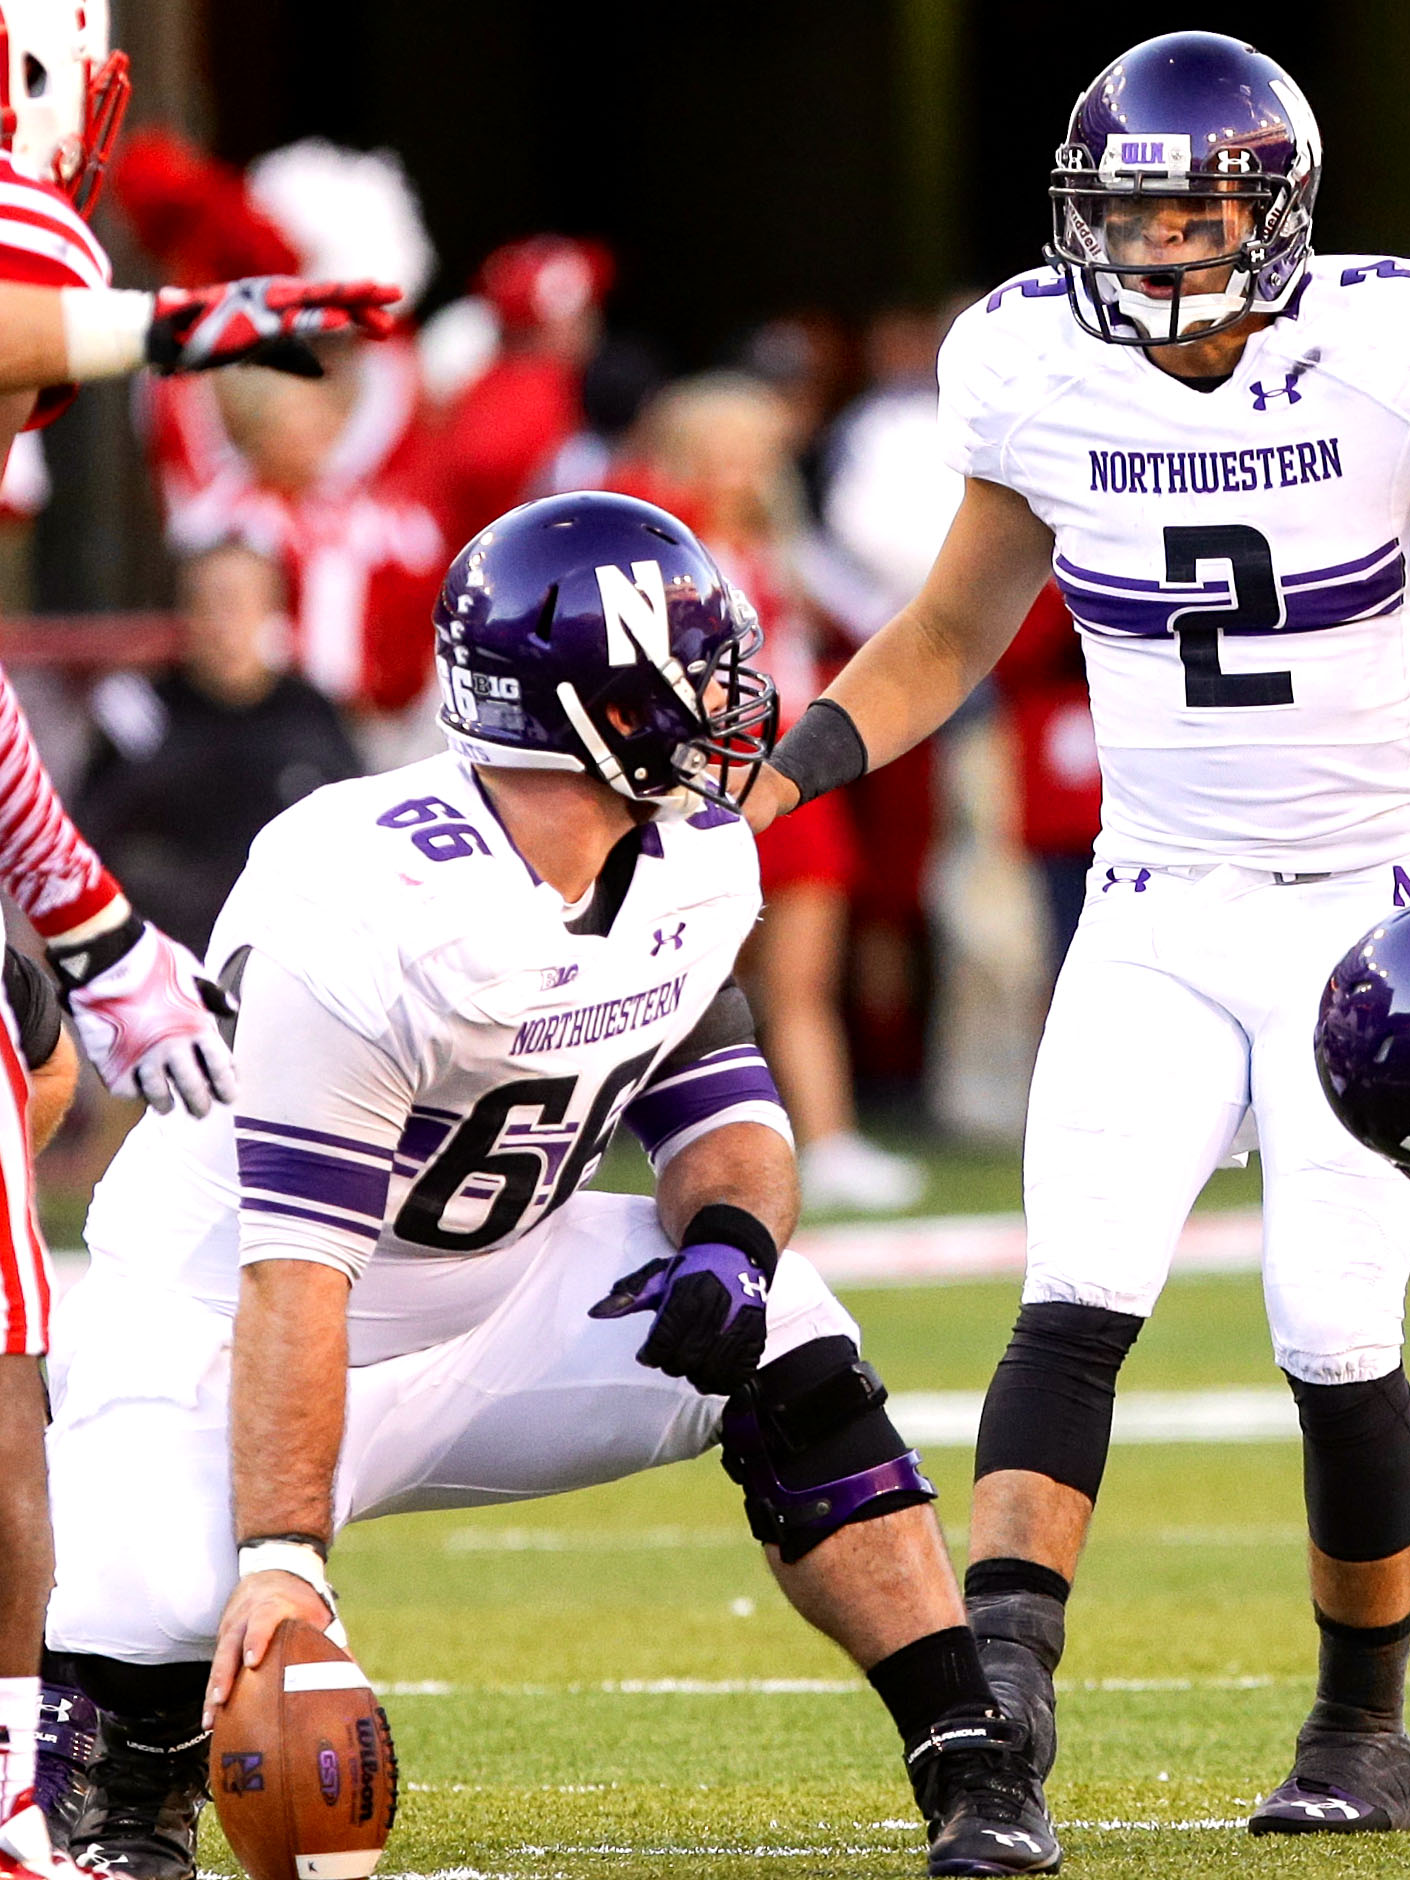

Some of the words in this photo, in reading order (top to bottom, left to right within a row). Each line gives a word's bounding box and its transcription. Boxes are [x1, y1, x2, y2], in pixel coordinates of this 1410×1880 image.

[1088, 437, 1343, 494] NORTHWESTERN
[594, 559, 673, 667] N
[1162, 523, 1295, 708] 2
[376, 795, 495, 863] 66
[508, 972, 688, 1057] NORTHWESTERN
